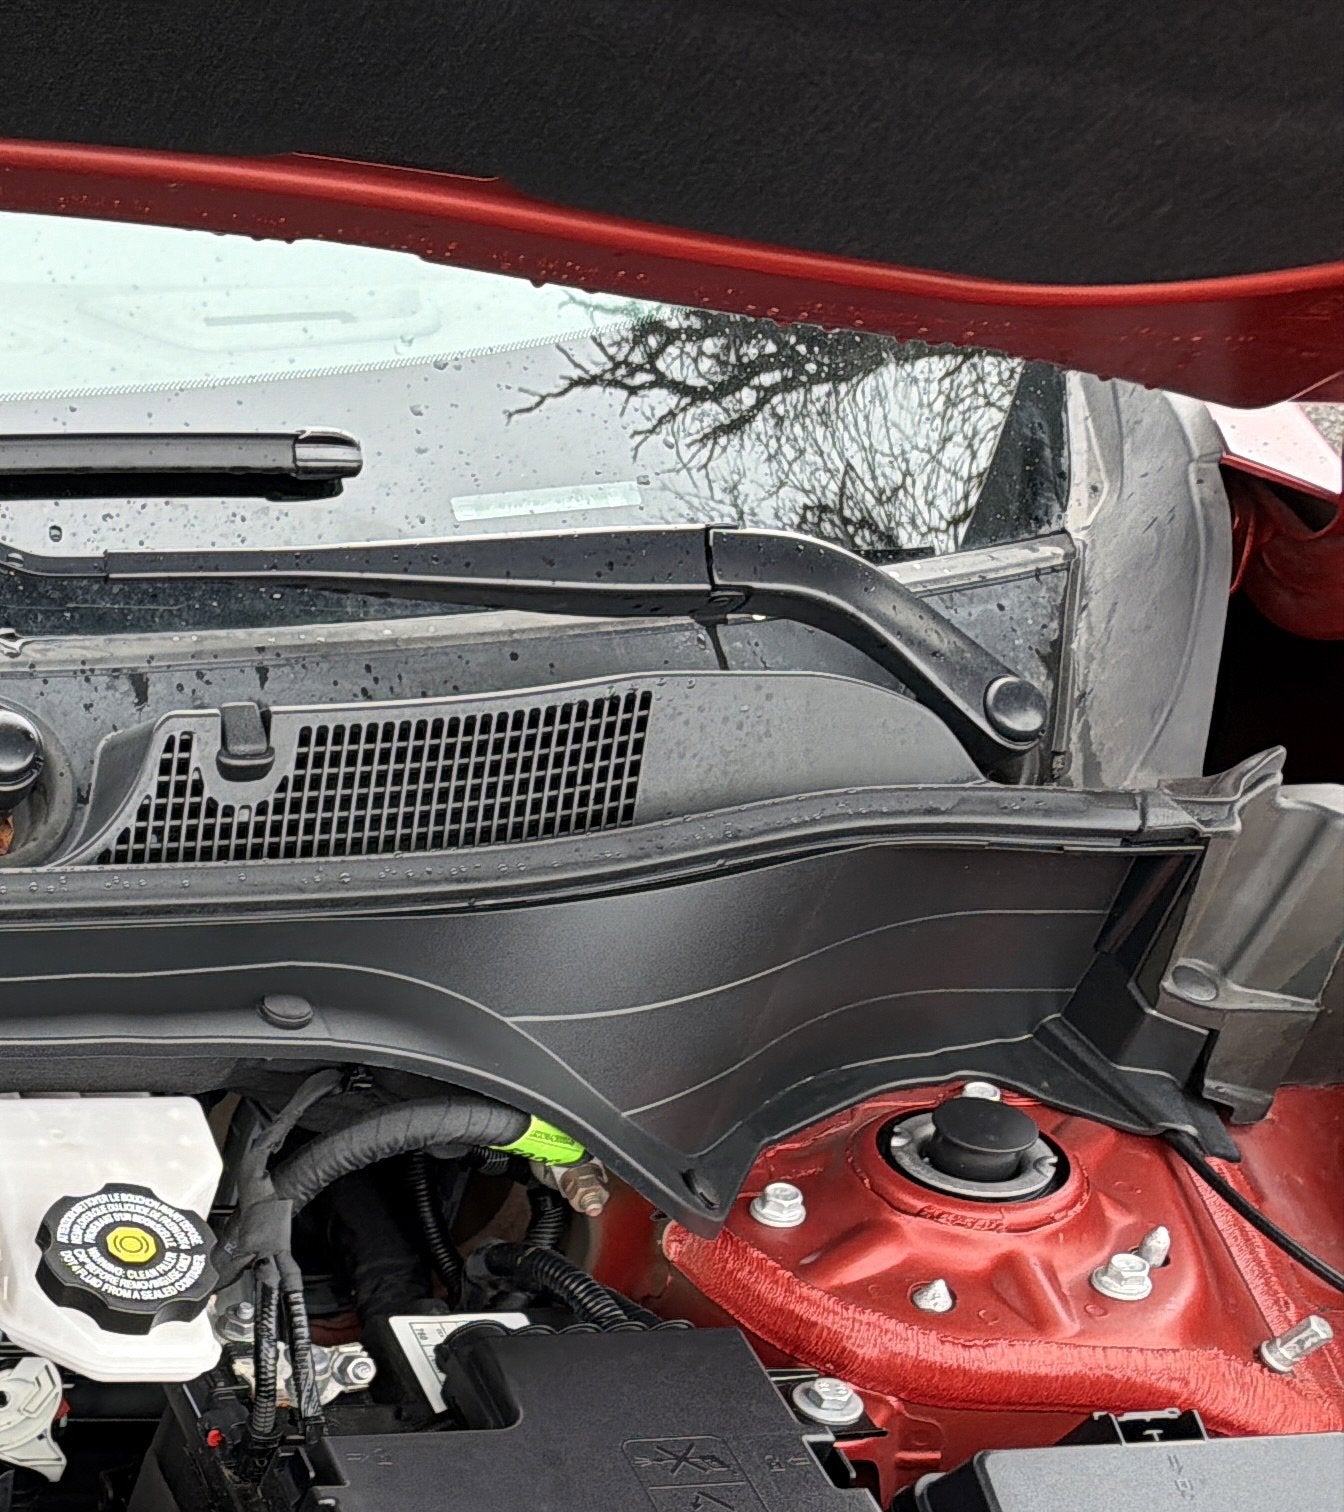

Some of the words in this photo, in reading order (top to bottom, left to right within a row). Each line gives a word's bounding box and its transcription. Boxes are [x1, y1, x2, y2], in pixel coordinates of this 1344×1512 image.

[60, 1250, 79, 1266] DOT
[75, 1268, 104, 1288] FLUID
[101, 1283, 132, 1299] FROM
[132, 1290, 140, 1300] A
[140, 1285, 178, 1300] SEALED
[73, 1249, 91, 1264] CAP
[85, 1262, 120, 1286] BEFORE
[126, 1268, 160, 1280] CLEAN
